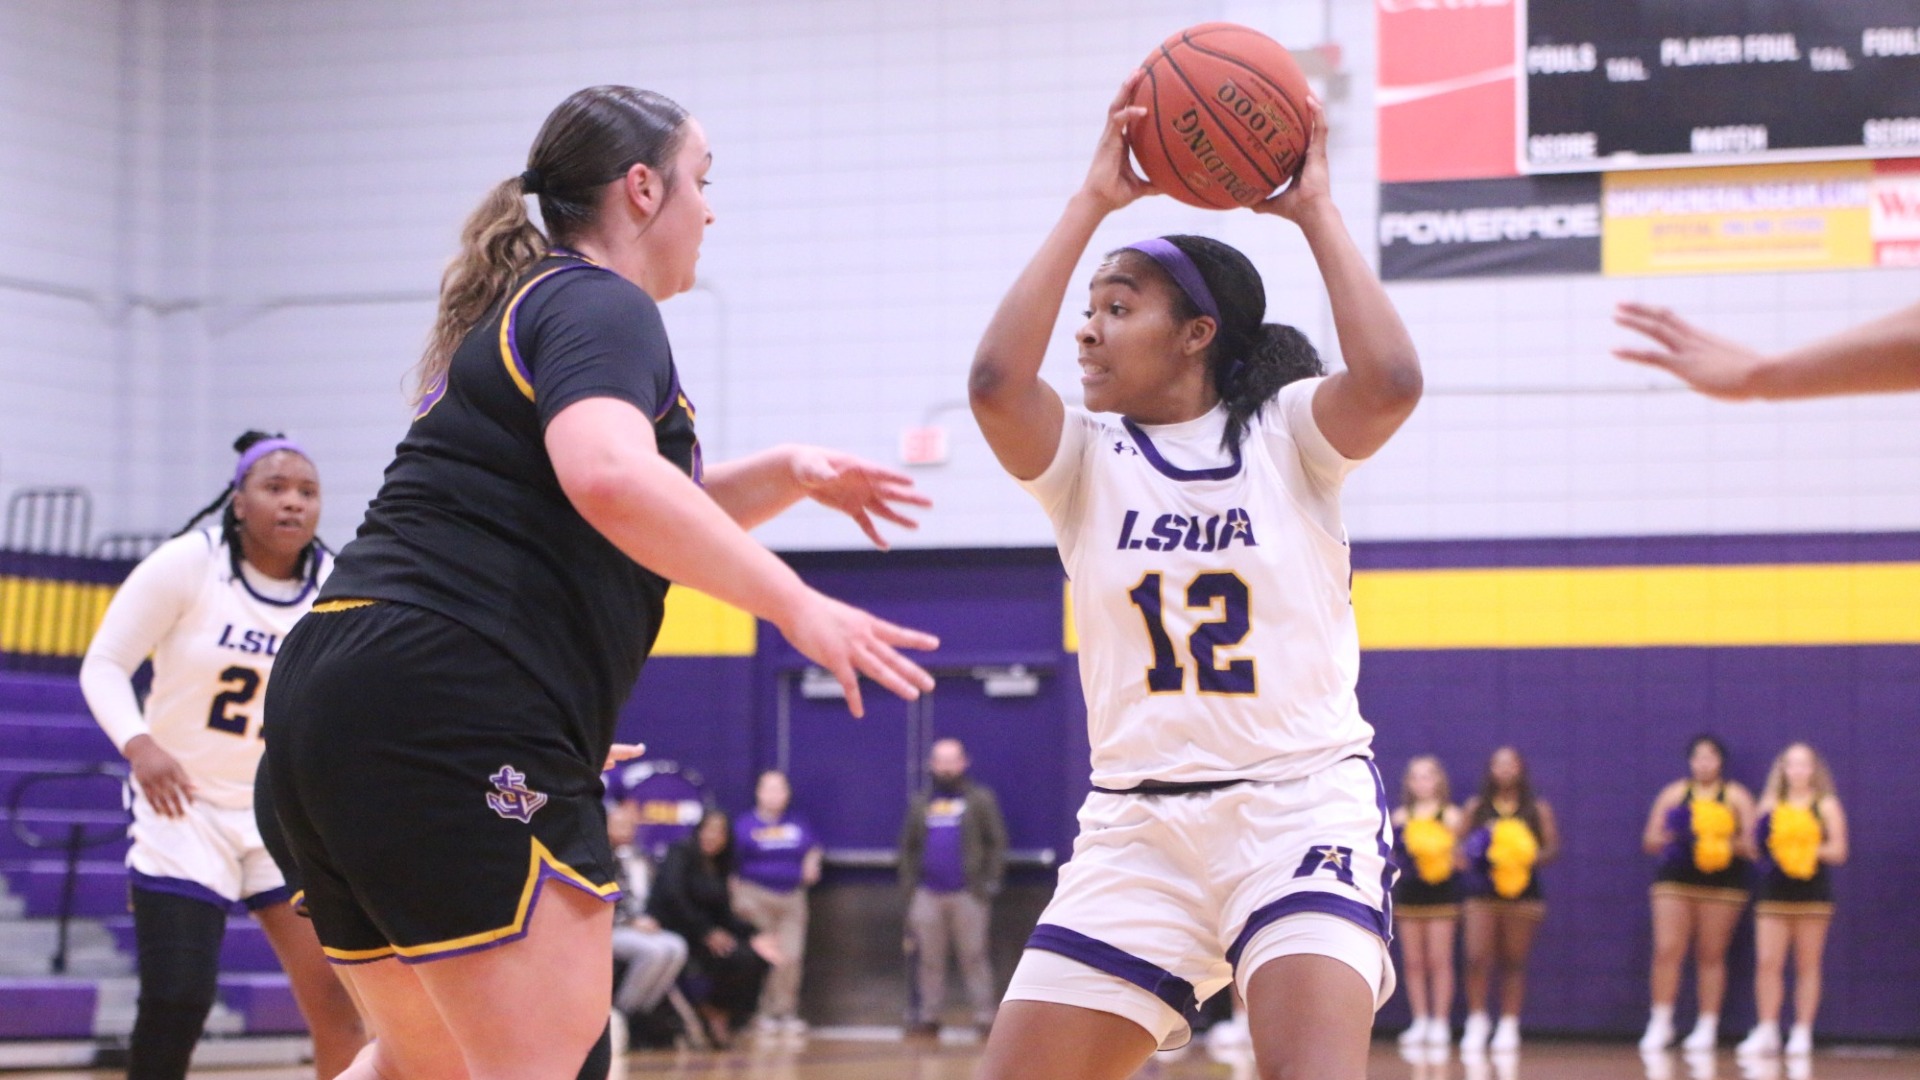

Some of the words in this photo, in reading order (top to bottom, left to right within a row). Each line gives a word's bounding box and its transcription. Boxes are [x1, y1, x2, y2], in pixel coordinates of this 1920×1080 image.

[1528, 42, 1597, 74] FOULS
[1660, 35, 1742, 67] PLAYER
[1743, 32, 1800, 63] FOUL
[1862, 26, 1920, 58] FOUL
[1529, 132, 1597, 161] SCORE
[1690, 124, 1768, 153] MATCH
[1863, 118, 1920, 147] SCOR
[1380, 203, 1600, 246] POWERADE
[1117, 507, 1259, 552] LSUA
[218, 624, 279, 656] LSU
[1126, 569, 1259, 697] 12
[206, 664, 265, 740] 2
